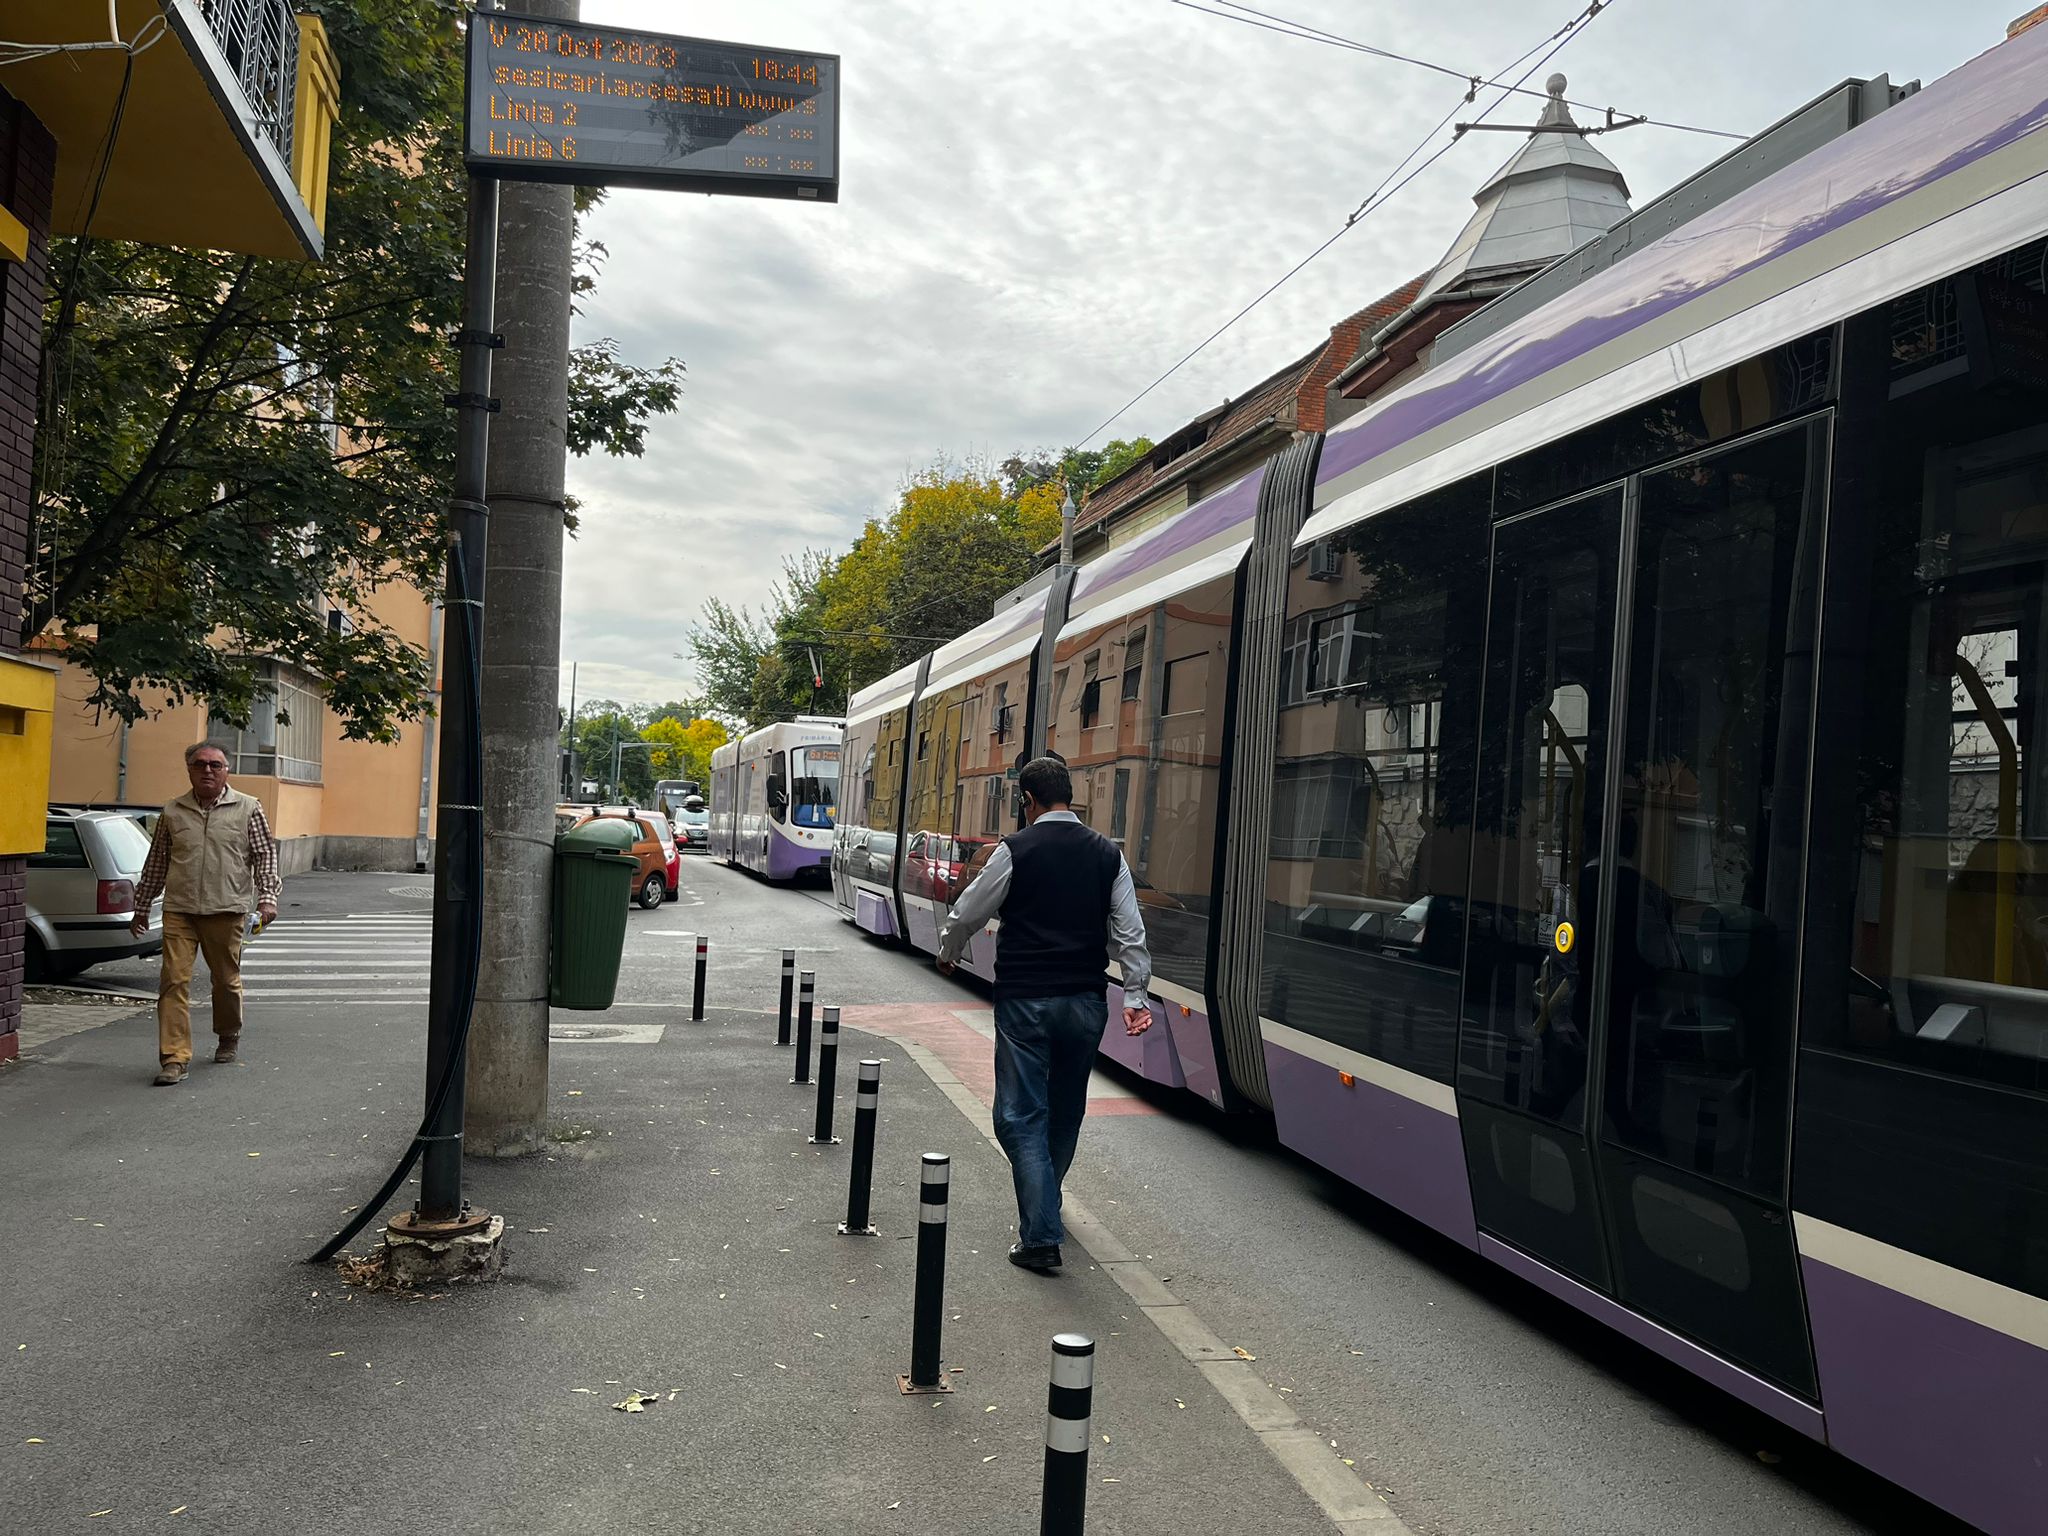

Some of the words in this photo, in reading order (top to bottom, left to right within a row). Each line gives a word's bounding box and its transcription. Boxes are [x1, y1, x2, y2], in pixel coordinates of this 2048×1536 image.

[489, 22, 509, 48] V
[557, 32, 602, 61] Oct
[611, 39, 677, 69] 2023
[752, 58, 817, 86] 10:44
[489, 95, 554, 124] Linia
[562, 101, 577, 126] 2
[488, 129, 553, 159] Linia
[562, 135, 577, 160] 6
